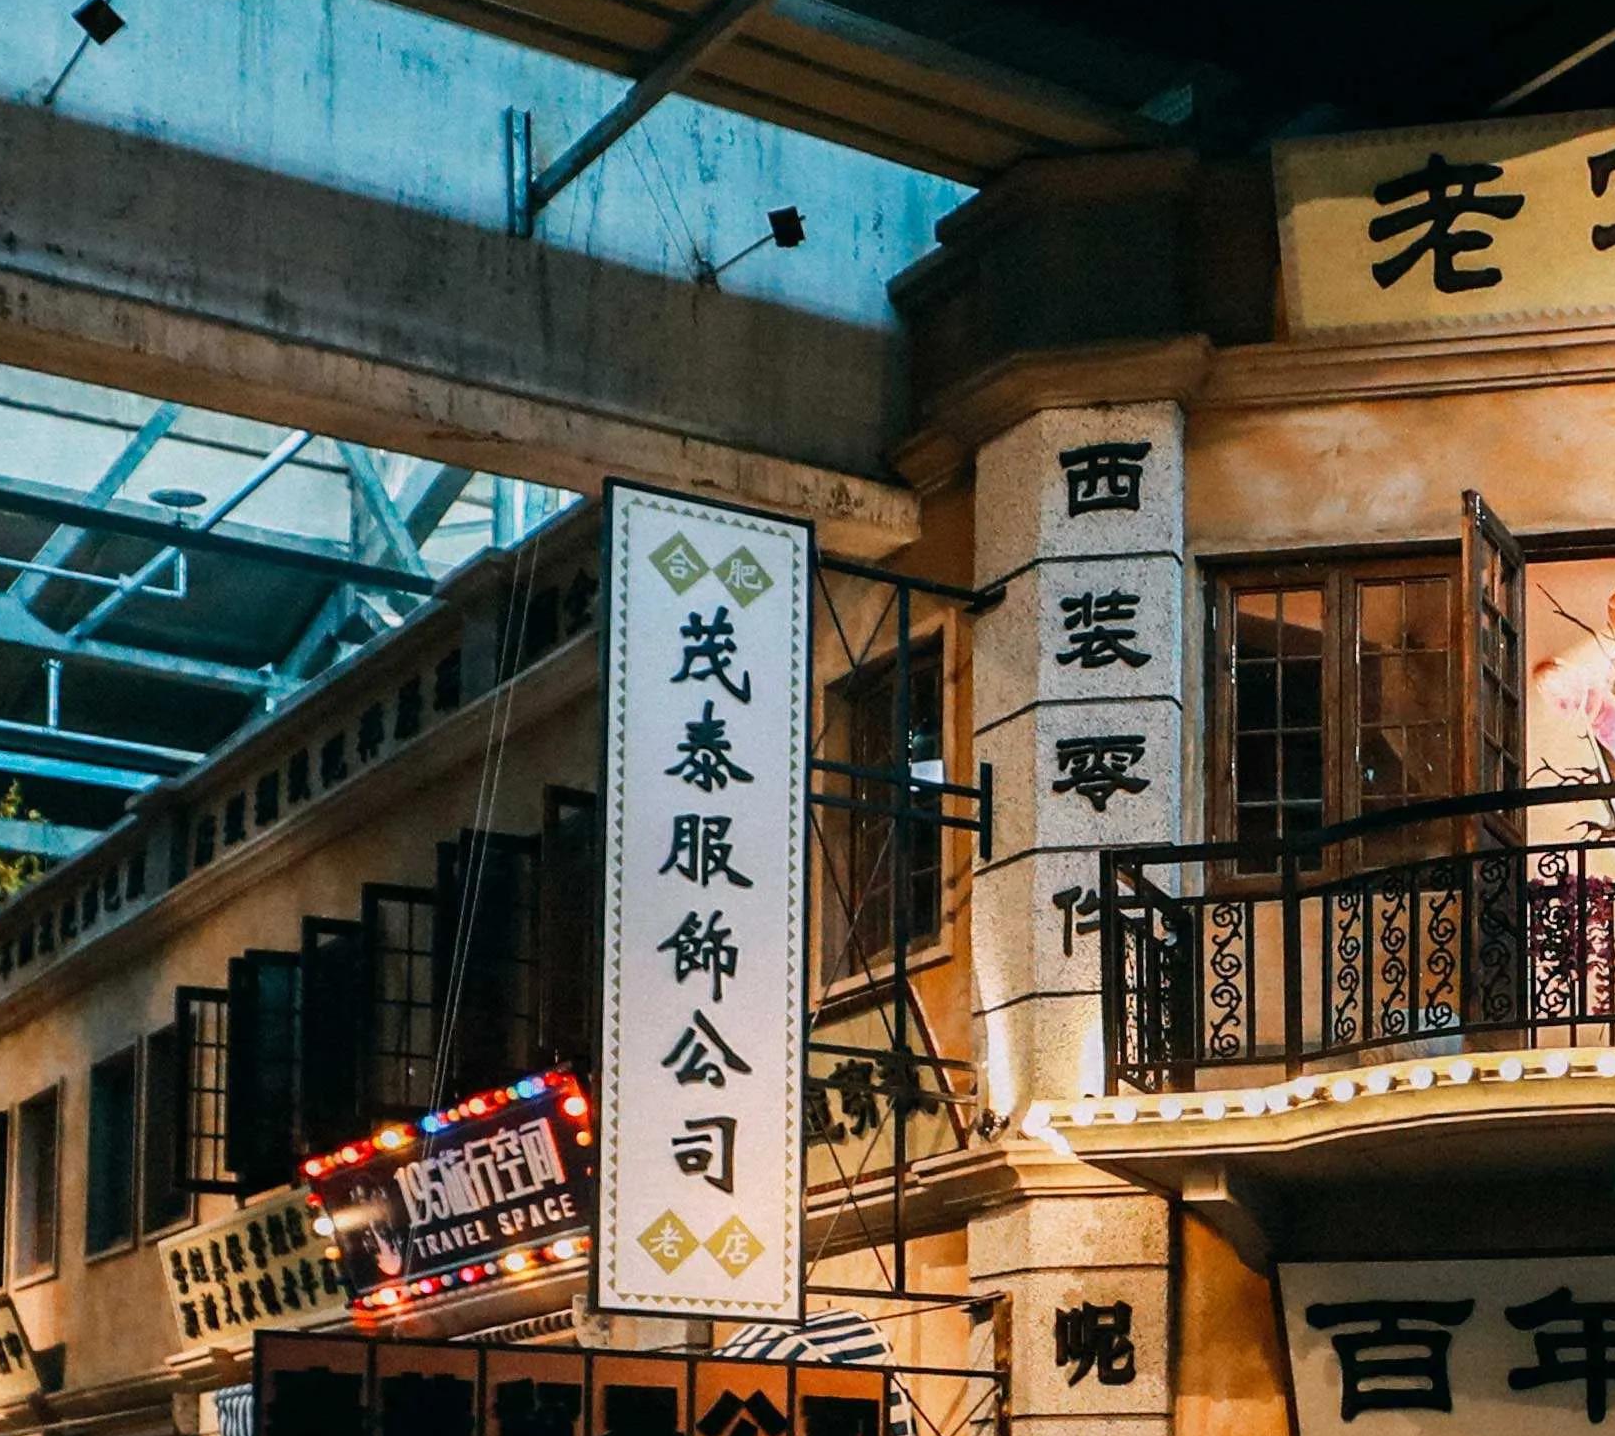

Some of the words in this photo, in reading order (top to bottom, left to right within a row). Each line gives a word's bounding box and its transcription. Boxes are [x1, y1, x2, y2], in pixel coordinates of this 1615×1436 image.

[659, 541, 763, 593] 合肥
[656, 605, 754, 1196] 茂泰服飾公司
[414, 1220, 490, 1257] TRAVEL
[497, 1193, 577, 1236] SPACE
[648, 1224, 750, 1268] 老店
